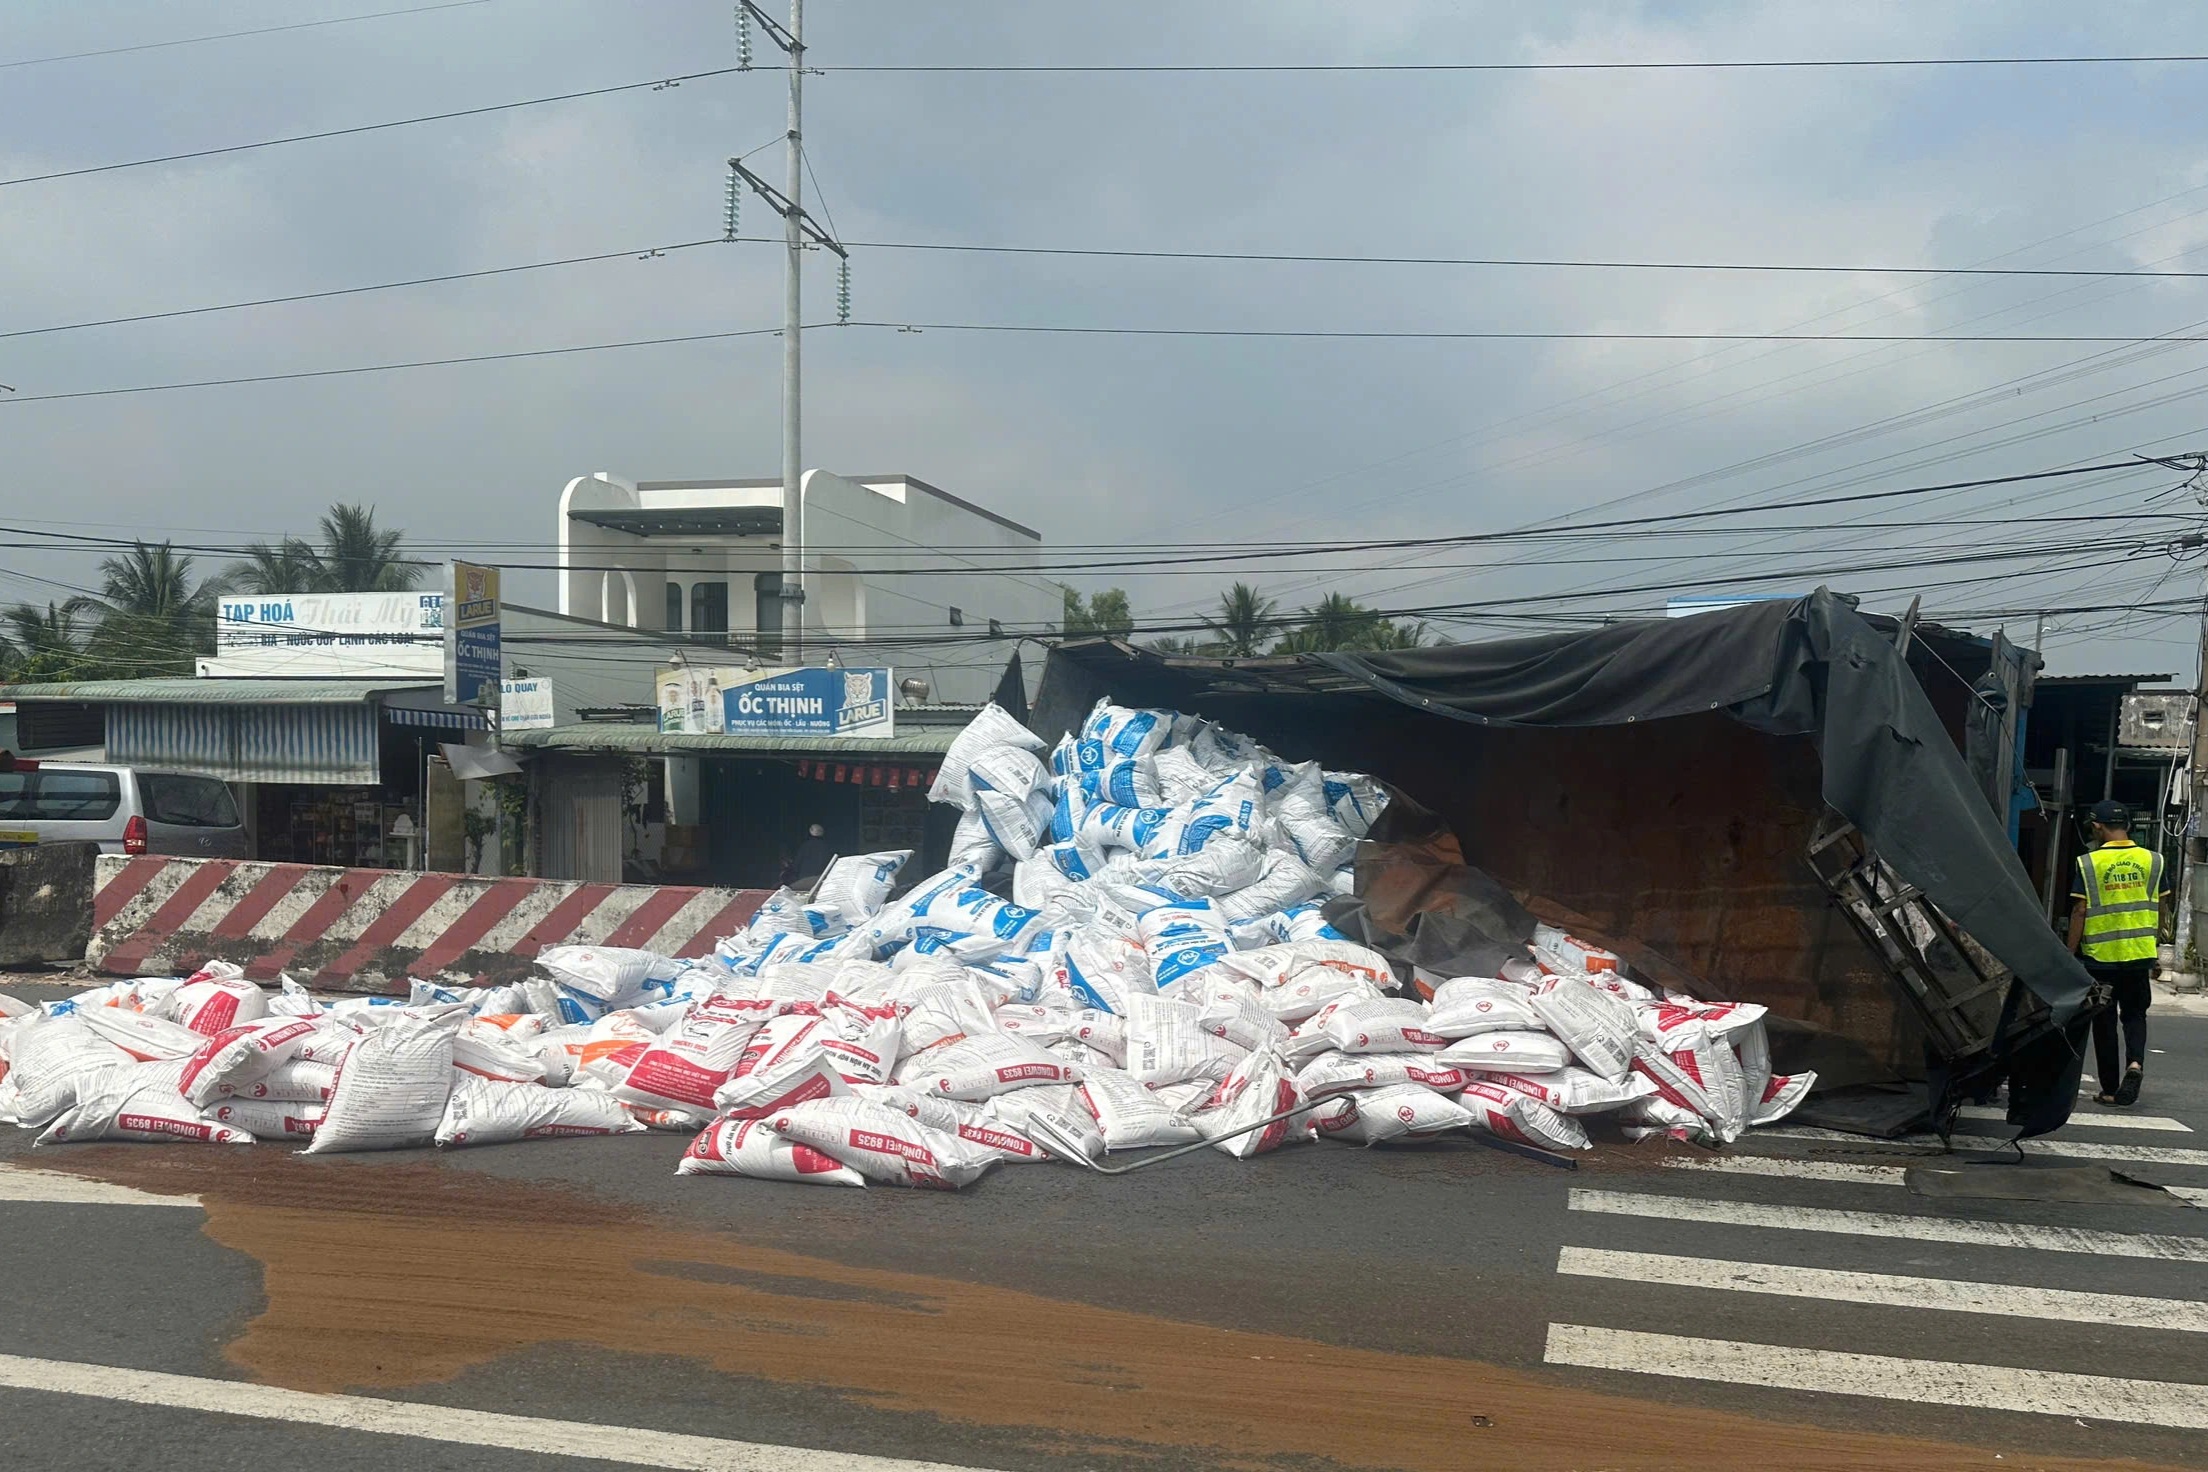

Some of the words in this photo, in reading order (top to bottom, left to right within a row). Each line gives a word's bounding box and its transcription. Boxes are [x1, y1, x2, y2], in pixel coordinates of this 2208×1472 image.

[260, 599, 294, 622] HOÁ
[461, 602, 492, 619] LARUE
[458, 639, 470, 657] ỐC
[471, 646, 499, 663] THỊNH
[515, 682, 537, 693] QUAY
[755, 682, 776, 692] QUÁN
[778, 684, 790, 692] BIA
[739, 692, 763, 714] ỐC
[767, 697, 822, 718] THỊNH
[838, 702, 881, 725] LARUE
[2113, 874, 2126, 882] 118
[2127, 872, 2138, 881] TG
[1003, 1067, 1022, 1079] 8935
[1024, 1064, 1054, 1077] TONGWEI
[1491, 1072, 1508, 1085] 8935
[1509, 1077, 1544, 1098] TONGWEI
[127, 1117, 151, 1129] 8935
[154, 1119, 201, 1136] TONGWEI
[858, 1134, 883, 1149] 8935
[886, 1137, 927, 1160] TONGWEI
[984, 1130, 1025, 1151] TONGWEI
